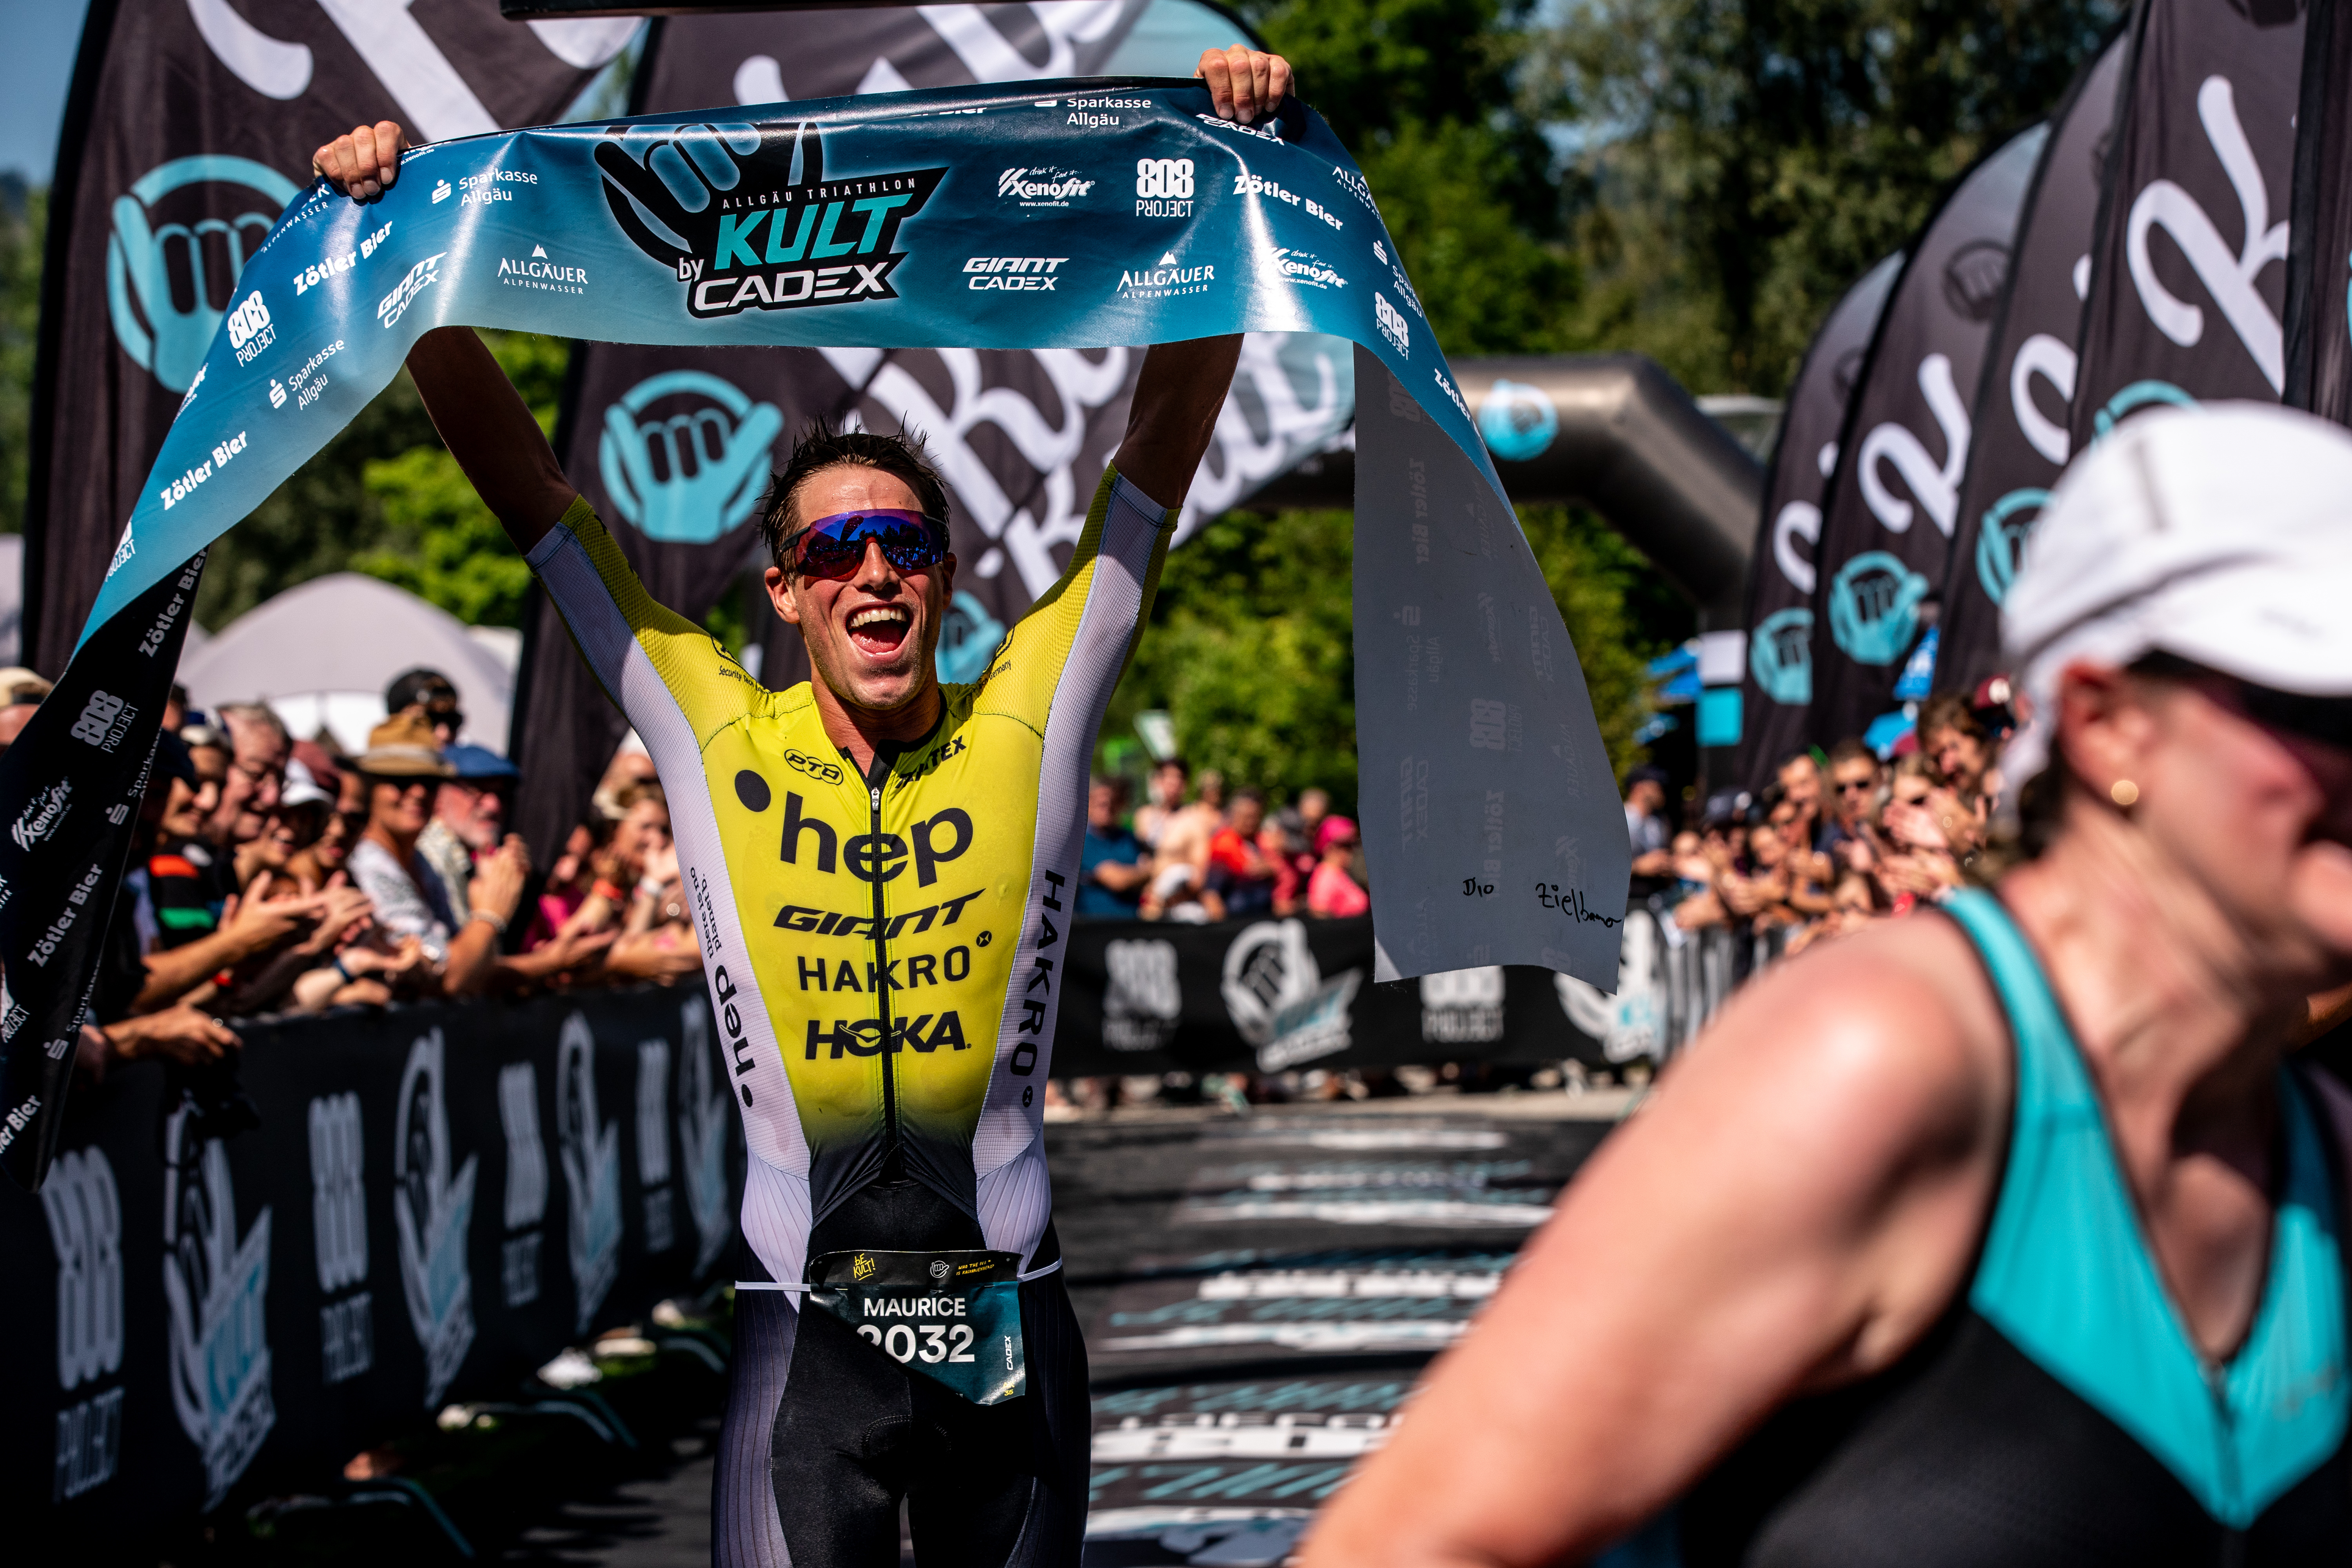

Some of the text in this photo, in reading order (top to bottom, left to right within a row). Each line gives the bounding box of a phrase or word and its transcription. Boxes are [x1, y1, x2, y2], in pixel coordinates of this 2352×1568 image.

[1066, 113, 1120, 128] Allgäu
[1067, 97, 1151, 109] Sparkasse
[458, 168, 538, 190] Sparkasse
[1029, 167, 1047, 176] drink
[1052, 171, 1068, 183] feel
[1137, 158, 1194, 199] 808
[461, 188, 512, 207] Allgäu
[723, 178, 916, 209] ALLGÄU TRIATHLON
[1136, 200, 1193, 217] PROJECT
[1232, 175, 1343, 230] Zötler Bier
[714, 193, 914, 270] KULT
[294, 221, 392, 296] Zötler Bier
[497, 258, 588, 285] ALLGÄUER
[963, 258, 1069, 272] GIANT
[1117, 265, 1214, 292] ALLGÄUER
[377, 252, 447, 319] GIANT
[384, 270, 439, 329] CADEX
[503, 278, 584, 295] ALPENWASSER
[679, 258, 889, 311] by CADEX
[968, 276, 1058, 290] CADEX
[1122, 284, 1208, 299] ALPENWASSER
[1394, 281, 1422, 318] Allgäu
[227, 290, 270, 349] 808
[1375, 292, 1409, 347] 808
[1376, 318, 1409, 360] PROJECT
[236, 323, 277, 367] PROJECT
[289, 340, 345, 391] Sparkasse
[298, 374, 328, 410] Allgäu
[1435, 368, 1470, 422] Zötler
[161, 431, 248, 510] Zötler Bier
[138, 549, 207, 657] Zötler Bier
[719, 665, 742, 681] Security
[989, 659, 1011, 680] Germany
[71, 690, 124, 746] 808
[101, 702, 138, 753] PROJECT
[787, 753, 840, 784] PTO
[780, 791, 974, 888] hep
[27, 864, 103, 967] Zötler Bier
[690, 867, 714, 959] there is no
[705, 892, 722, 952] planet
[773, 888, 987, 940] GIANT
[797, 944, 970, 994] HAKRO
[1010, 869, 1065, 1076] HAKRO
[715, 964, 755, 1076] hep
[805, 1010, 967, 1060] HOKA
[5, 1095, 42, 1132] Bier
[853, 1258, 876, 1278] KULT!
[864, 1298, 966, 1317] MAURICE
[1004, 1335, 1013, 1370] CADEX
